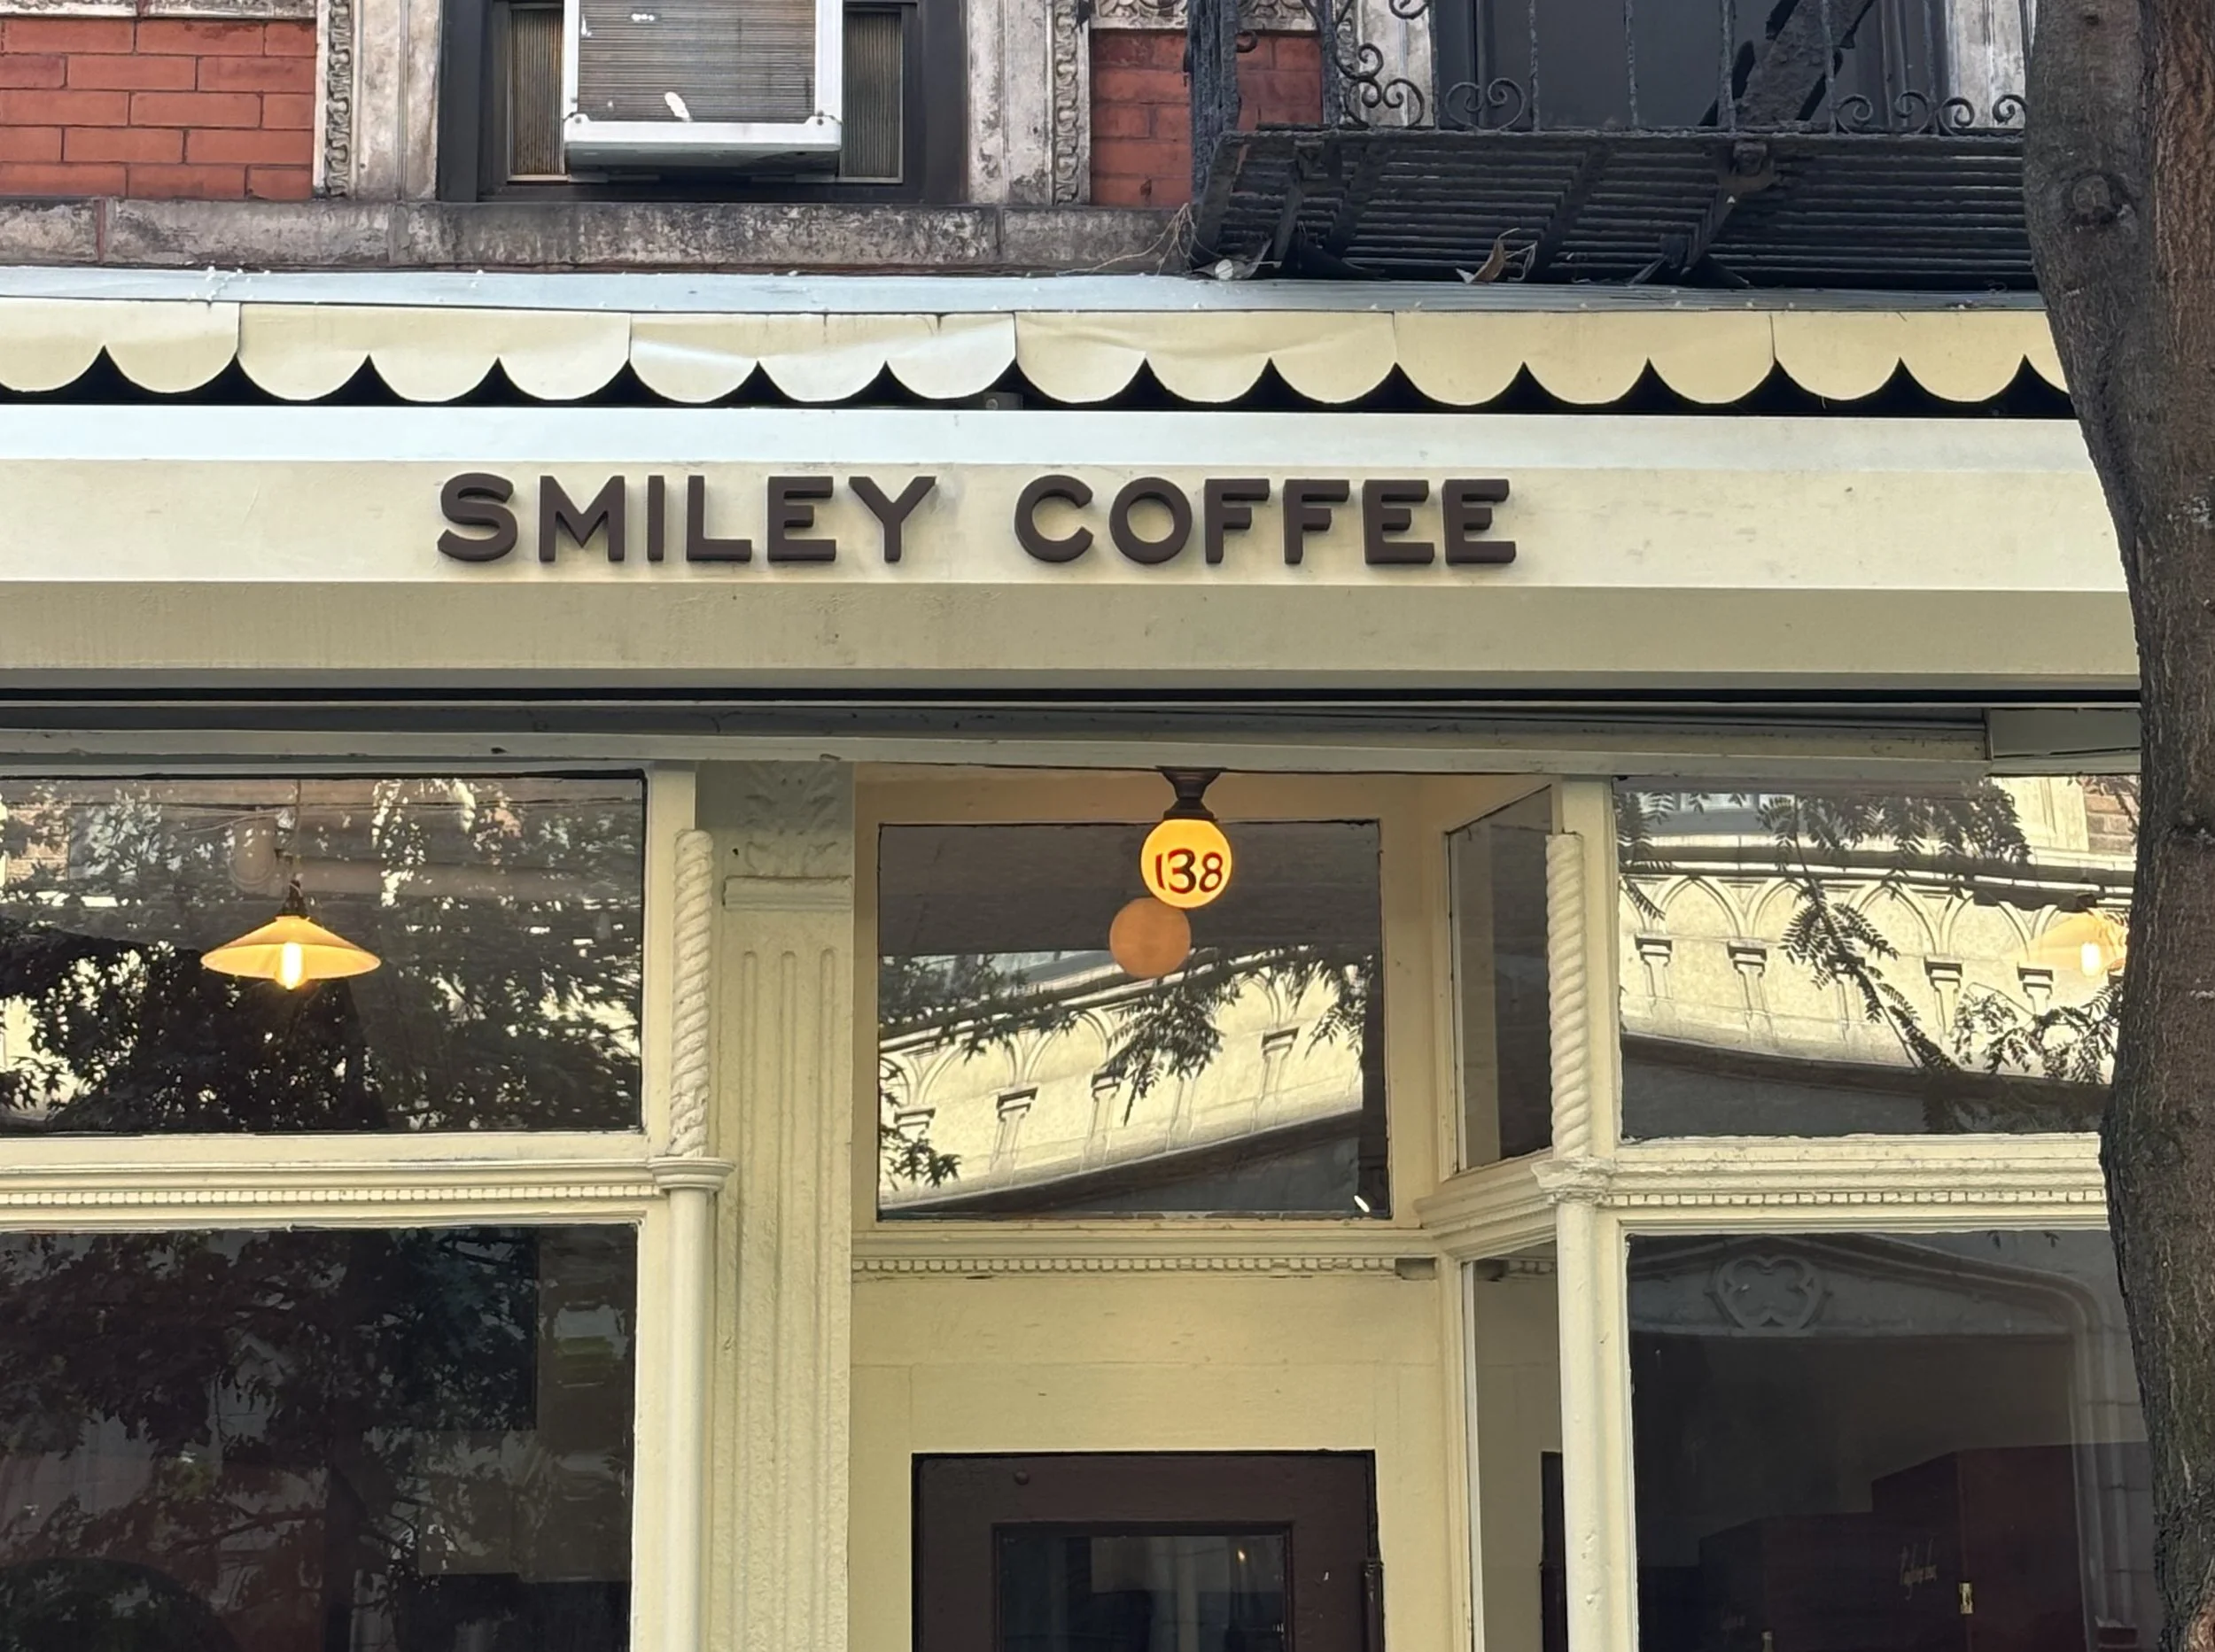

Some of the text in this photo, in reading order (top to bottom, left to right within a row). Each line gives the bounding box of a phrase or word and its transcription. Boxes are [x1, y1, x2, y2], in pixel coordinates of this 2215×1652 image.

[437, 472, 1516, 567] SMILEY COFFEE
[1155, 848, 1224, 895] 138
